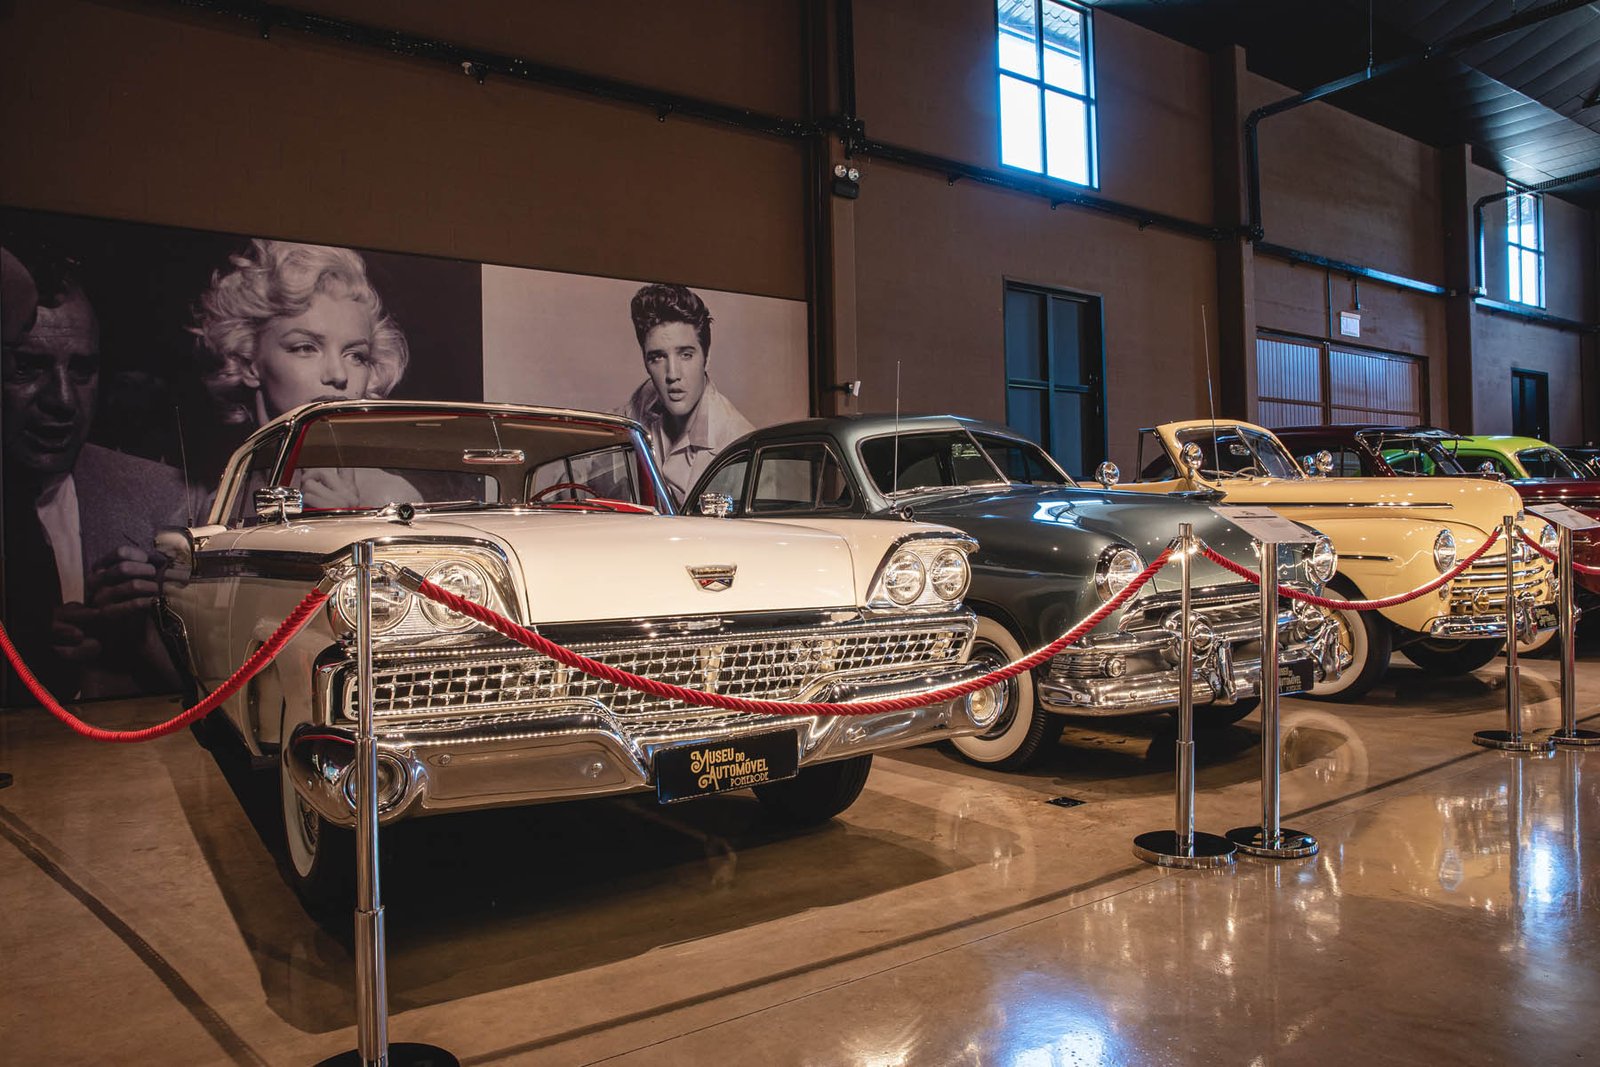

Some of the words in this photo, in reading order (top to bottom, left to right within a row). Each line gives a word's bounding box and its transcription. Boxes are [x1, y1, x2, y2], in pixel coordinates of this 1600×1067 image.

[690, 747, 734, 774] MUSEU
[735, 752, 745, 762] DO
[698, 758, 769, 790] AUTOMÓVEL
[730, 772, 769, 787] POMERODE
